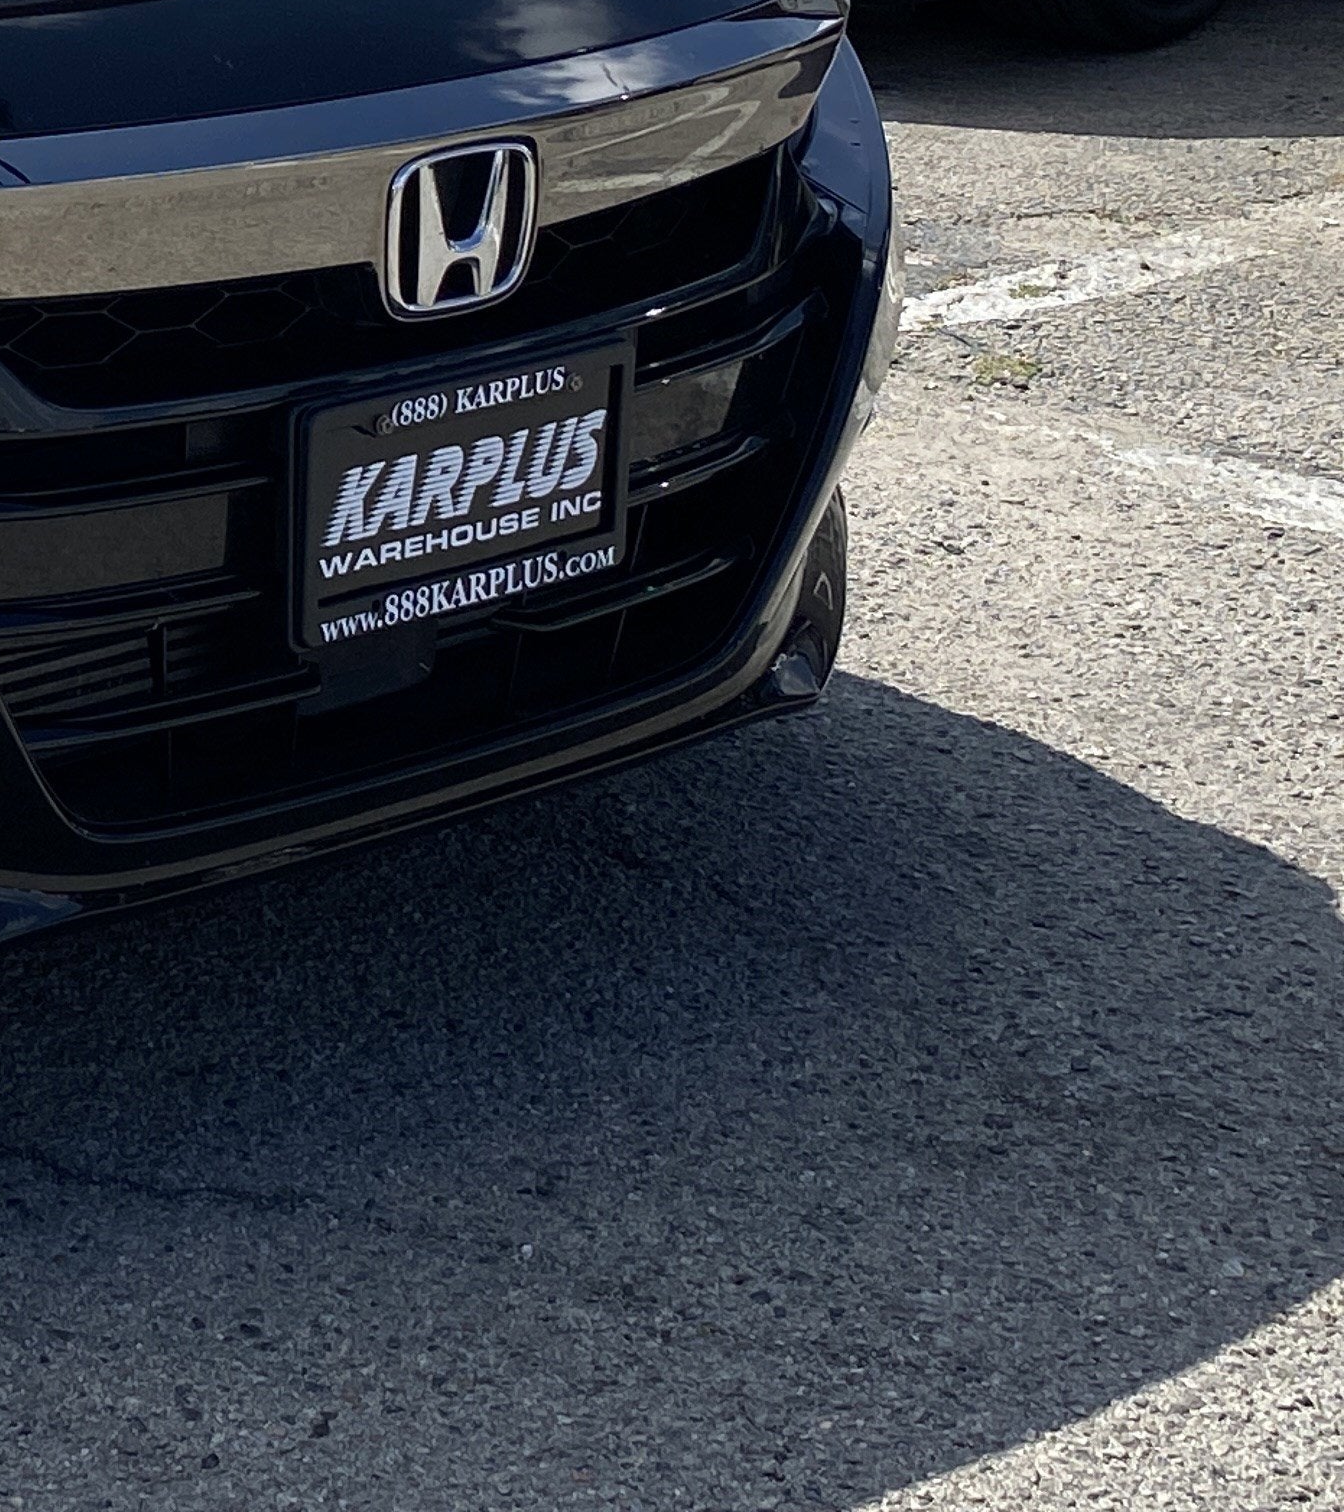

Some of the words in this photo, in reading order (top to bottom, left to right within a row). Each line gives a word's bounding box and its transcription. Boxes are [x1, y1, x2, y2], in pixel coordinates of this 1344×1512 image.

[391, 392, 449, 428] (888)
[454, 366, 566, 415] KARPLUS
[319, 408, 608, 548] KARPLUS
[318, 508, 541, 580] WAREHOUSE
[550, 490, 603, 523] INC
